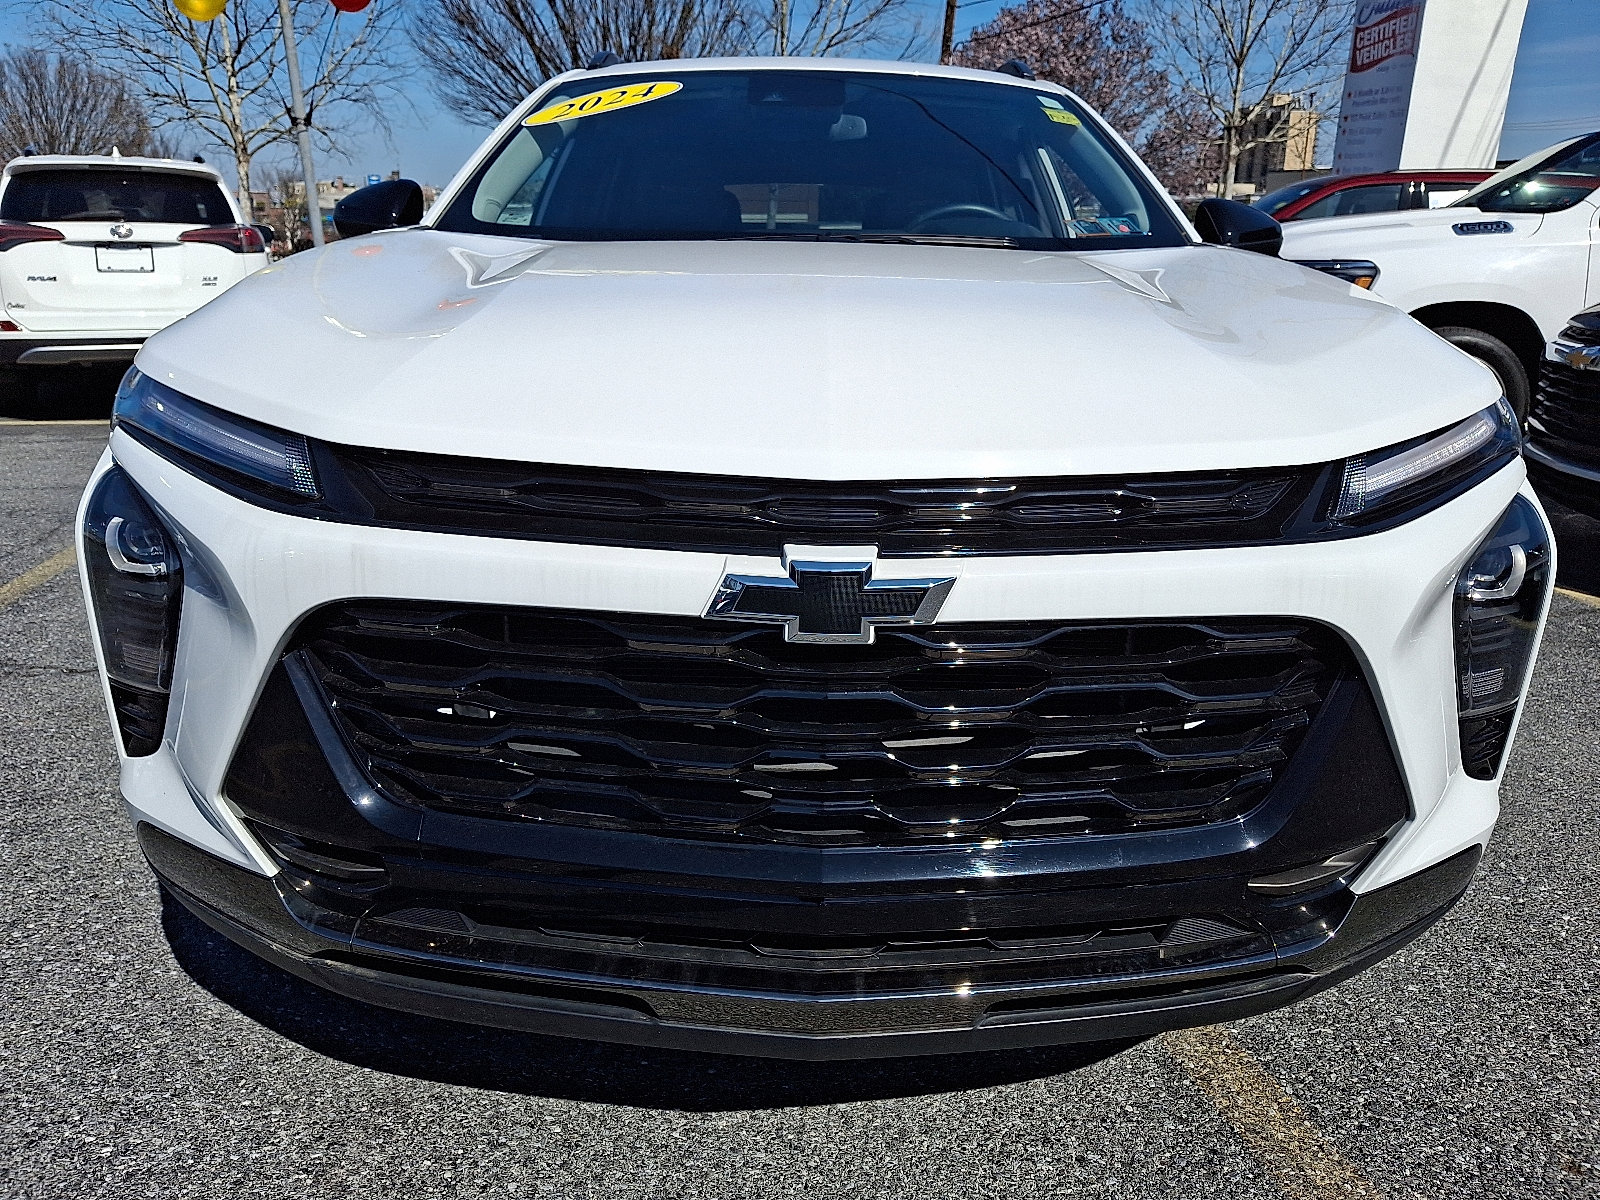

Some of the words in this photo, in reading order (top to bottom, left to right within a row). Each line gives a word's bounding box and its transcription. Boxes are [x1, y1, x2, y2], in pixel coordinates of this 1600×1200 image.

[1356, 12, 1417, 49] CERTIFIED
[1356, 33, 1414, 66] VEHICLES
[551, 83, 657, 120] 2024
